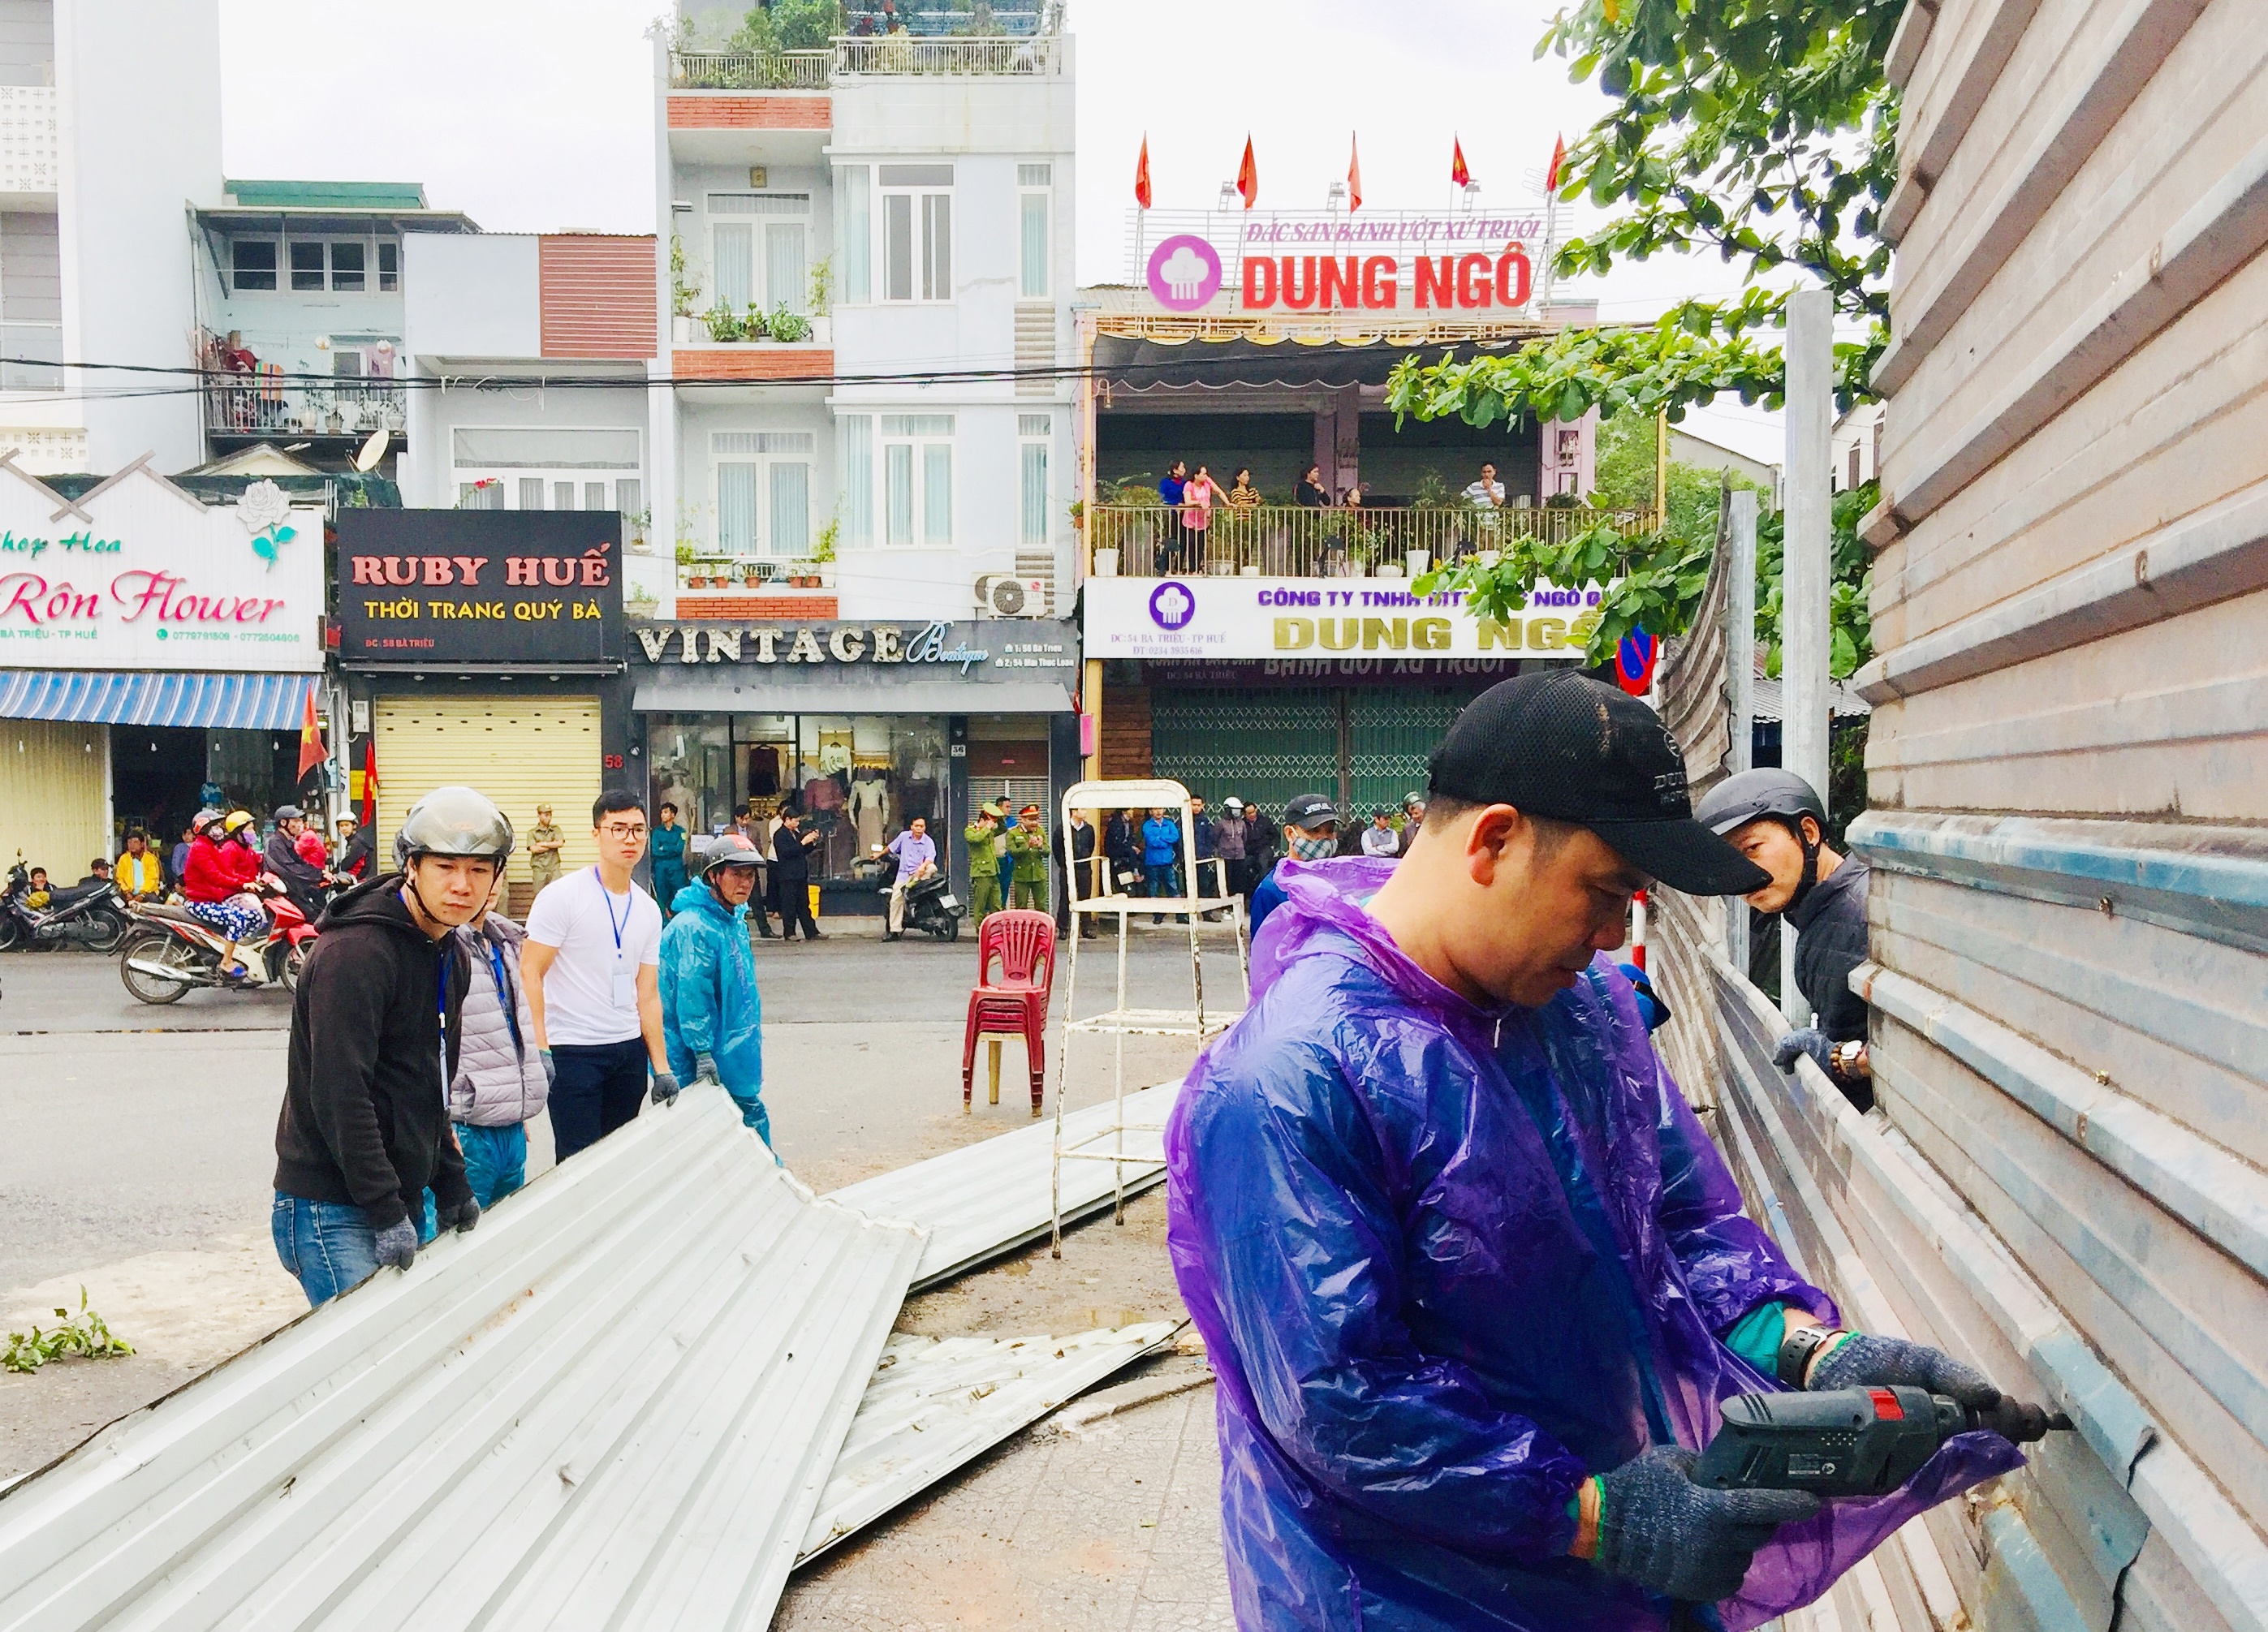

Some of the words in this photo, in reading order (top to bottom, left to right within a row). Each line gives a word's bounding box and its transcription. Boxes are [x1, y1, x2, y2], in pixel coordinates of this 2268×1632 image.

[1242, 256, 1397, 309] DUNG
[1414, 241, 1532, 309] NGÔ
[0, 529, 49, 560] hop
[58, 531, 122, 553] Hoa
[351, 556, 489, 586] RUBY
[505, 541, 611, 587] HUẾ
[110, 569, 286, 623] Flower
[364, 596, 420, 619] THỜI
[427, 601, 507, 620] TRANG
[513, 598, 563, 622] QUÝ
[571, 597, 602, 620] BÀ
[1258, 587, 1321, 607] CÔNG
[1326, 591, 1354, 607] TY
[58, 630, 71, 639] TP
[634, 625, 905, 664] VINTAGE
[905, 619, 990, 676] Boutique
[1273, 617, 1452, 650] DUNG
[605, 754, 624, 769] 58
